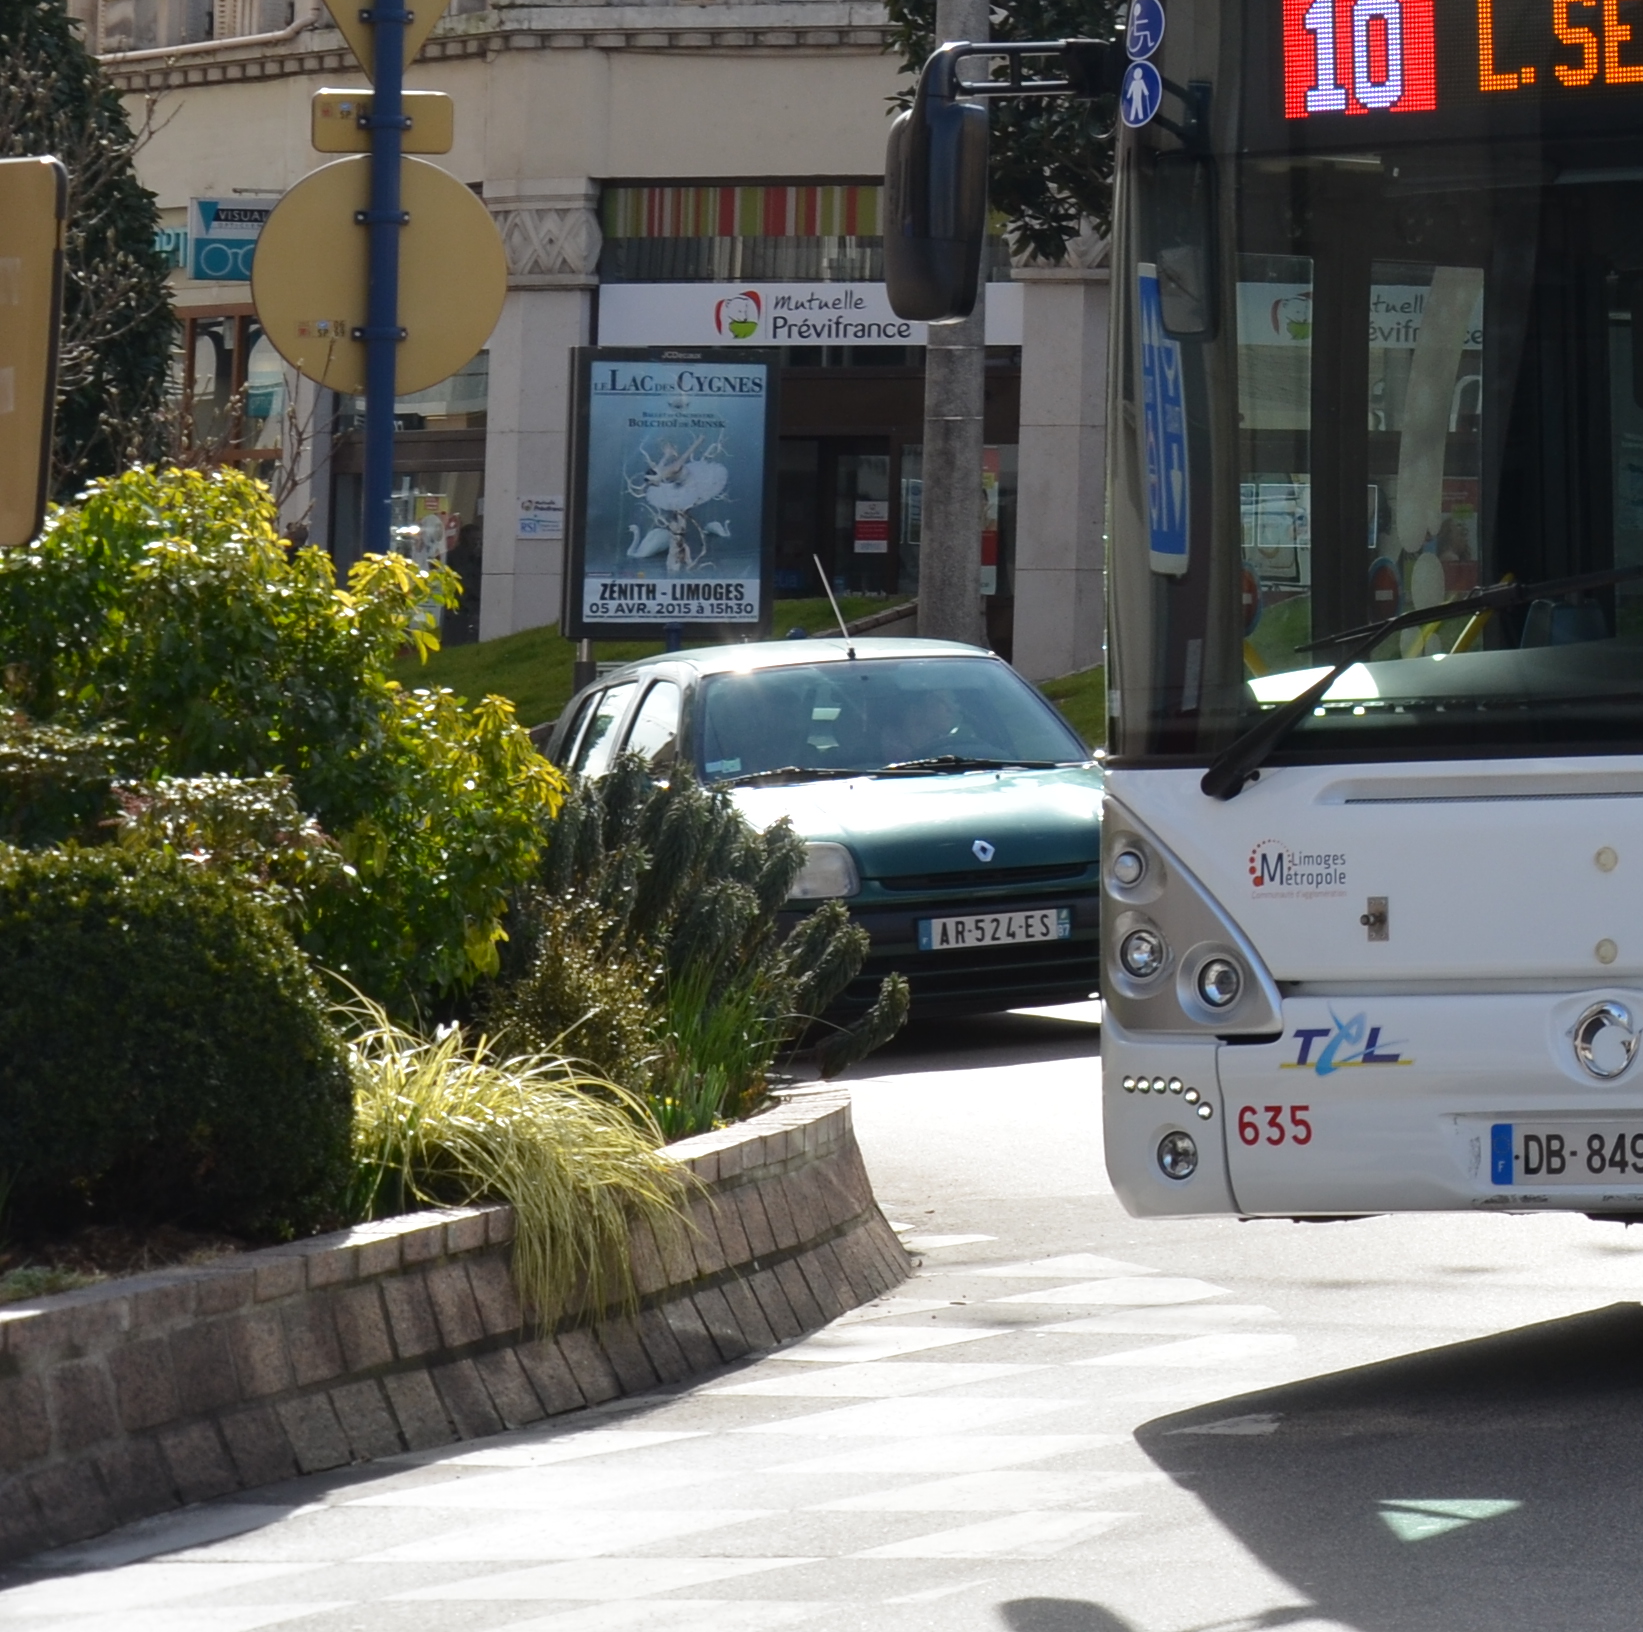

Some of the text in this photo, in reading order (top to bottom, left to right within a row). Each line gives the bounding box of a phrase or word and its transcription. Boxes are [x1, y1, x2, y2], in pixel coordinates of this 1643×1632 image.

[218, 209, 270, 221] VISUAL
[773, 290, 866, 310] Mutuelle
[772, 316, 911, 339] Prévifrance
[609, 369, 653, 391] LAC
[655, 383, 675, 391] DES
[677, 371, 763, 393] CYGNES
[600, 580, 656, 601] ZÉNITH
[671, 583, 744, 601] LIMOGES
[589, 602, 754, 615] 05 AVR. 2015 à 15h30
[1292, 852, 1346, 869] Limoges
[940, 914, 1050, 946] AR-524-ES
[1238, 1105, 1312, 1146] 635
[1498, 1161, 1505, 1173] F
